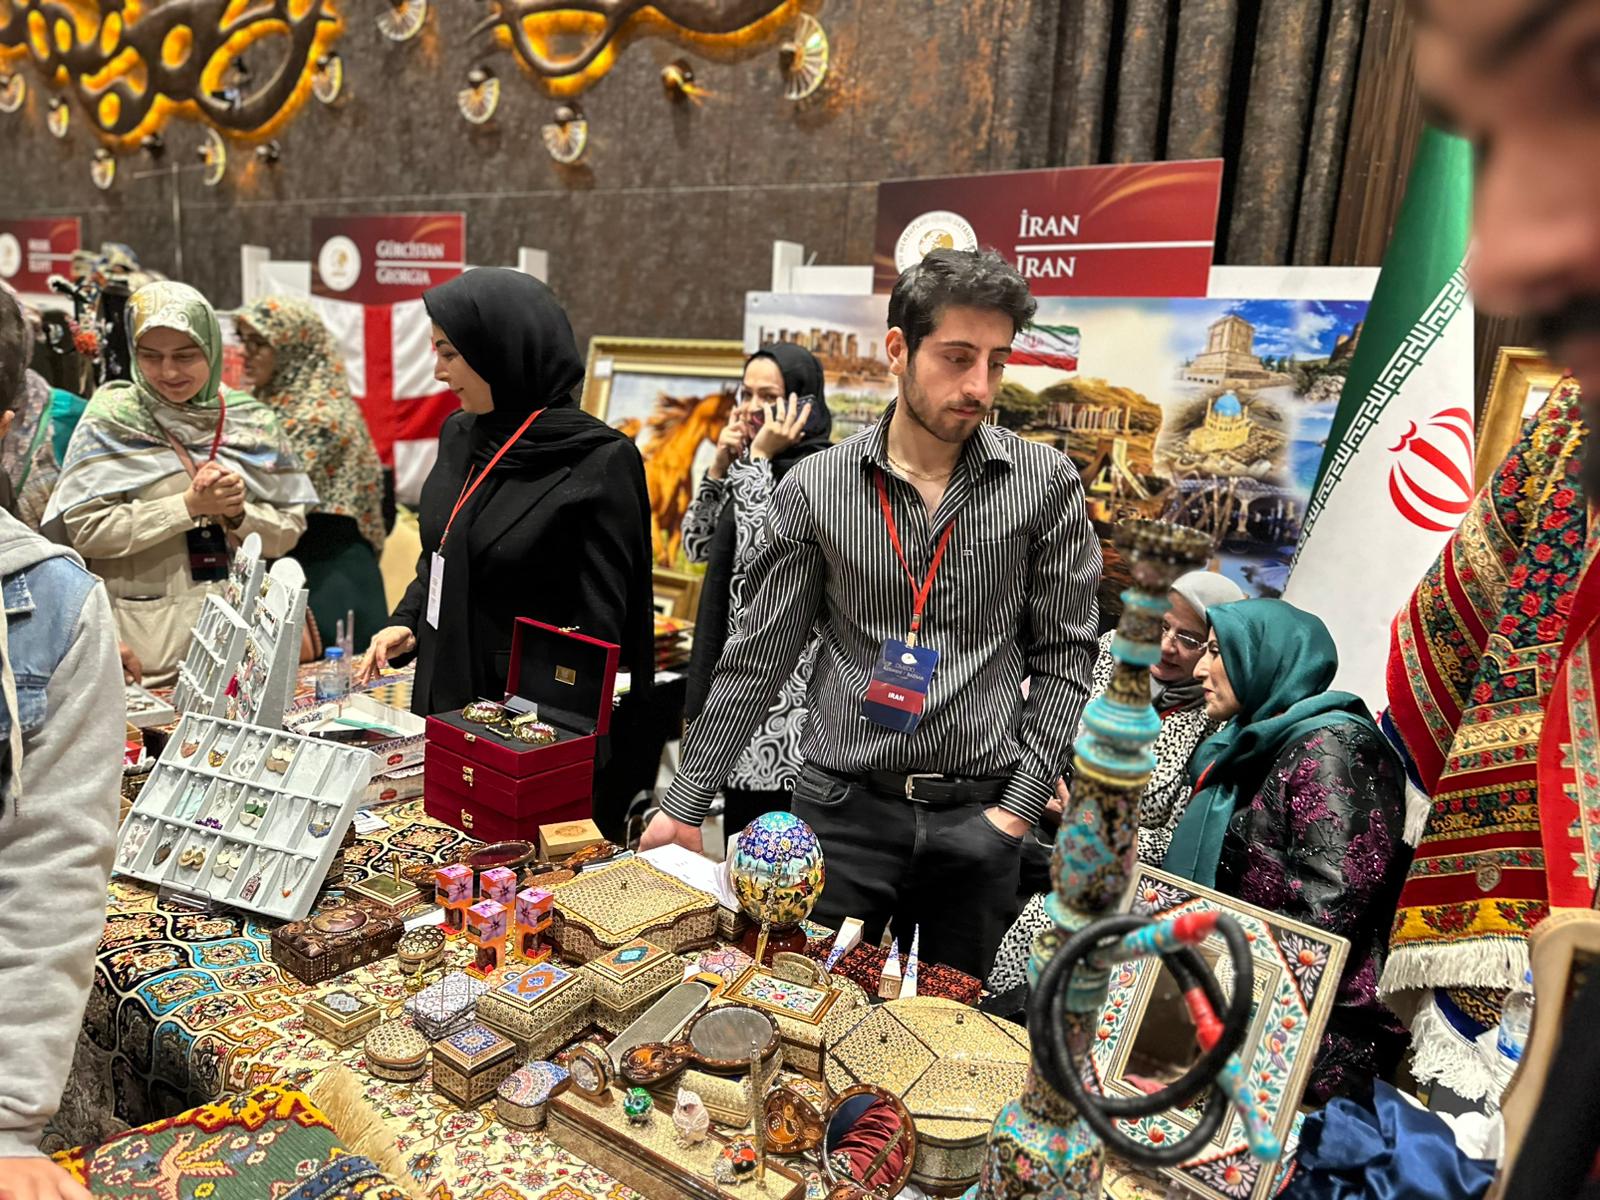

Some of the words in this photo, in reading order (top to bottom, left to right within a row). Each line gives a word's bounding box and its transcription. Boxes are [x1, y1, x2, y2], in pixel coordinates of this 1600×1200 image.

[1018, 208, 1080, 238] İRAN
[375, 267, 432, 285] GEORGIA
[1016, 254, 1076, 278] IRAN
[887, 691, 905, 702] IRAN
